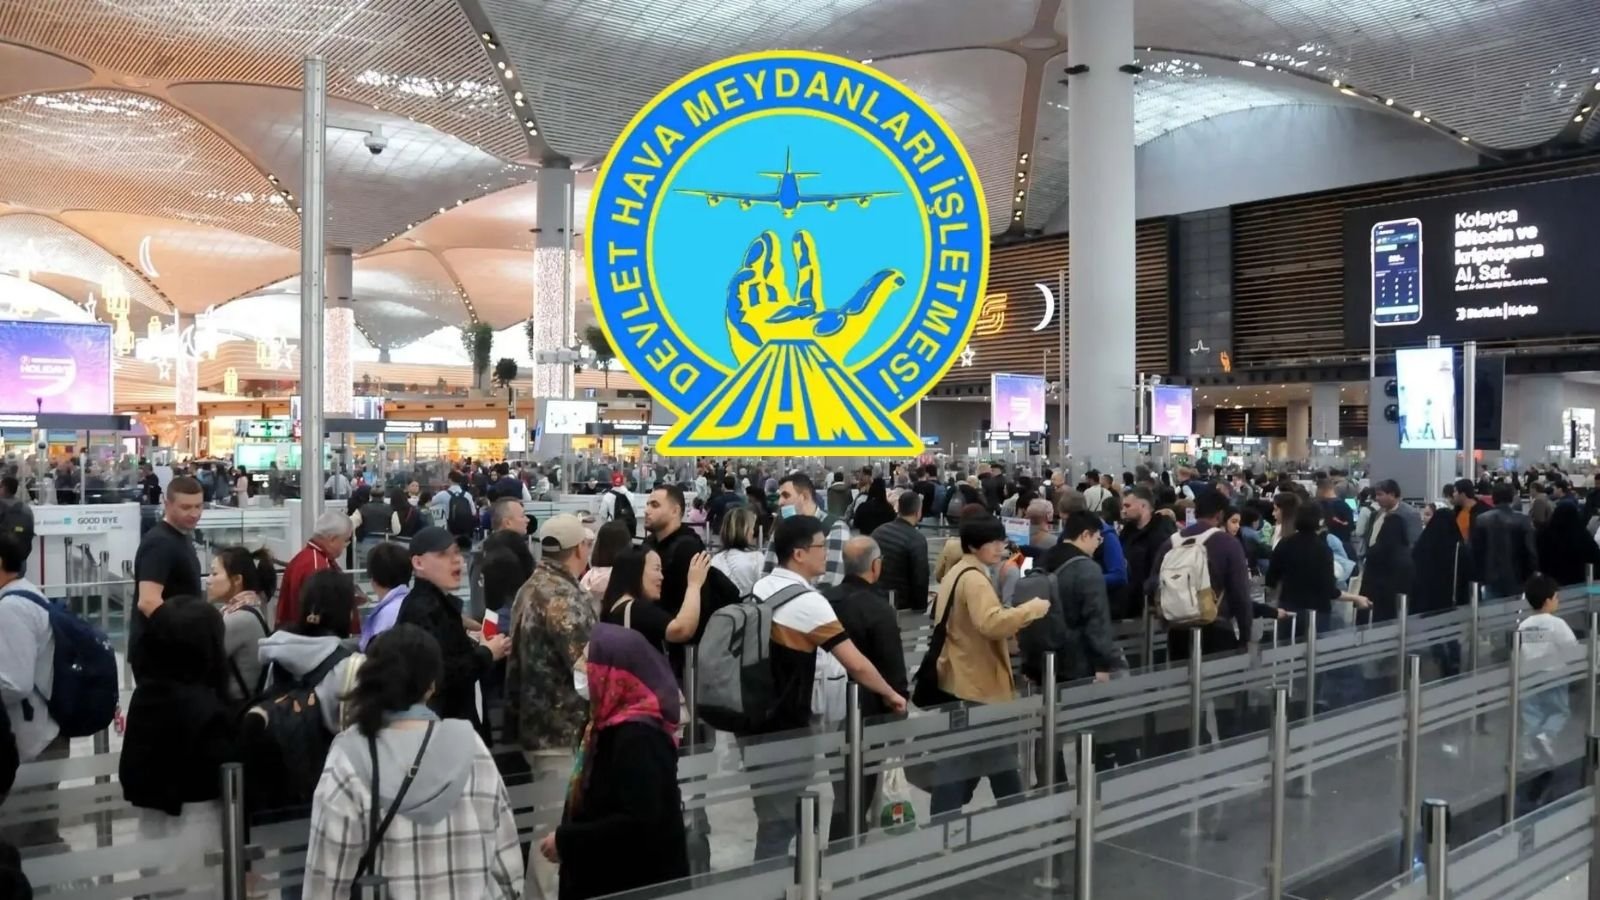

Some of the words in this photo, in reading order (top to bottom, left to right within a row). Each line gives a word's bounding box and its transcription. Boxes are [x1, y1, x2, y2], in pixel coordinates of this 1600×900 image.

[1455, 209, 1518, 229] Kolayca
[1455, 225, 1514, 247] Bitcoin
[1515, 226, 1539, 240] ve
[1455, 244, 1544, 266] kriptopara
[1455, 266, 1476, 283] Al,
[1478, 264, 1511, 281] Sat.
[77, 517, 100, 525] GOOD
[102, 516, 118, 524] BYE
